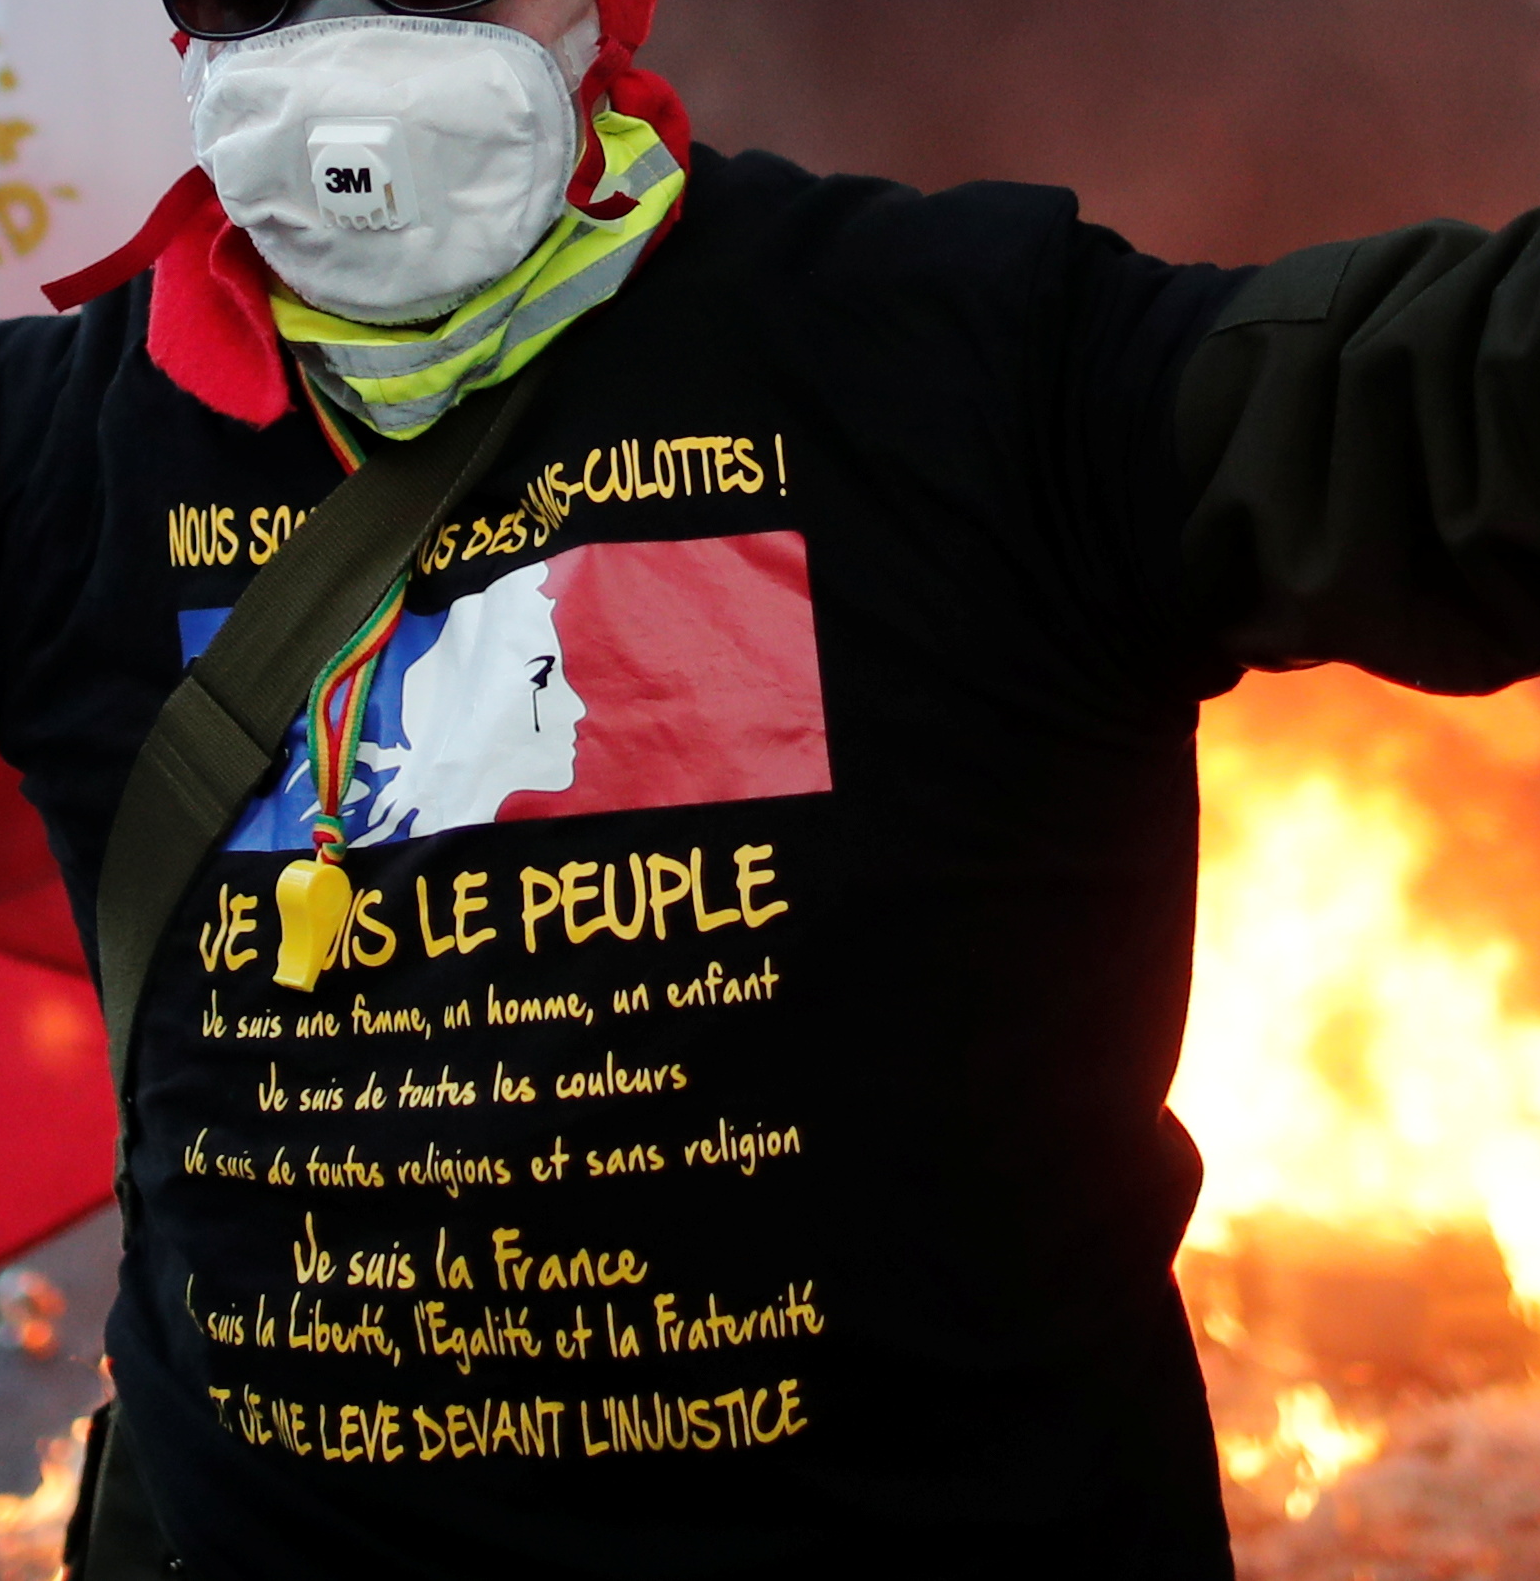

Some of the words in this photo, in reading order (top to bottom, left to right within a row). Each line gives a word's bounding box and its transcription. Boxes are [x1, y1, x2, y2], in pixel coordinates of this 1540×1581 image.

[324, 167, 372, 194] 3M
[168, 503, 240, 567] NOUS
[461, 508, 527, 561] DES
[198, 883, 259, 973] JE
[416, 870, 497, 959] LE
[520, 844, 789, 954] PEUPLE
[202, 989, 228, 1039] Je
[236, 1009, 283, 1039] suis
[295, 1011, 341, 1038] une
[351, 993, 432, 1041] femme,
[443, 999, 471, 1029] un
[487, 985, 594, 1026] homme,
[613, 983, 650, 1015] un
[666, 957, 780, 1008] enfant
[258, 1061, 289, 1112] Je
[298, 1082, 344, 1113] suis
[354, 1073, 387, 1111] de
[398, 1065, 477, 1109] toutes
[492, 1062, 537, 1104] les
[555, 1051, 688, 1100] couleurs
[184, 1128, 209, 1176] Je
[215, 1149, 256, 1181] suis
[267, 1147, 296, 1187] de
[305, 1145, 385, 1189] toutes
[397, 1143, 512, 1199] religions
[530, 1135, 570, 1182] et
[588, 1143, 666, 1177] sans
[684, 1118, 801, 1177] religion
[293, 1211, 337, 1286] Je
[346, 1246, 416, 1290] suis
[435, 1226, 474, 1291] la
[491, 1227, 649, 1291] France
[207, 1302, 245, 1347] suis
[255, 1293, 276, 1348] la
[288, 1291, 401, 1368] Liberté,
[555, 1305, 593, 1360] et
[606, 1302, 641, 1359] la
[653, 1279, 825, 1354] Fraternité
[238, 1383, 273, 1445] JE
[271, 1397, 313, 1457] ME
[319, 1399, 404, 1463] LEVE
[412, 1396, 566, 1463] DEVANT
[580, 1378, 809, 1458] L'INJUSTICE
